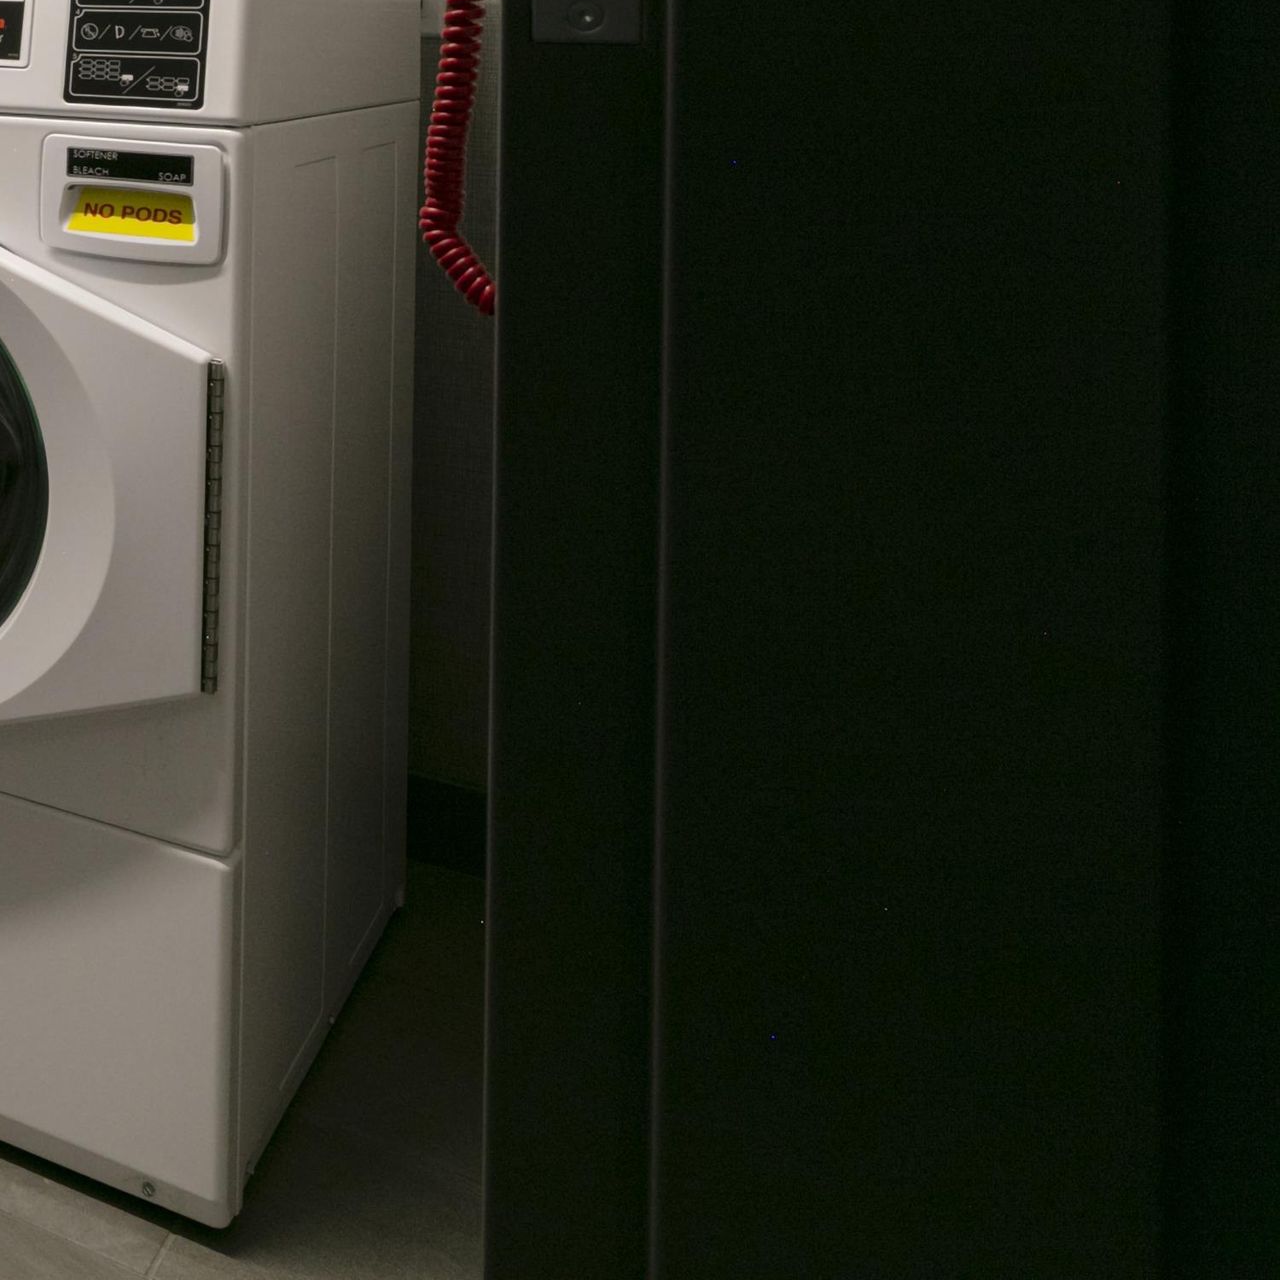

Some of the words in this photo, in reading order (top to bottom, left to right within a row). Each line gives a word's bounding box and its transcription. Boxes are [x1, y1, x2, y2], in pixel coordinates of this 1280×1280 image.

[73, 149, 118, 160] SOFTENER
[73, 165, 109, 175] BLEACH
[158, 172, 186, 181] SOAP
[84, 202, 114, 218] NO
[121, 205, 182, 224] PODS
